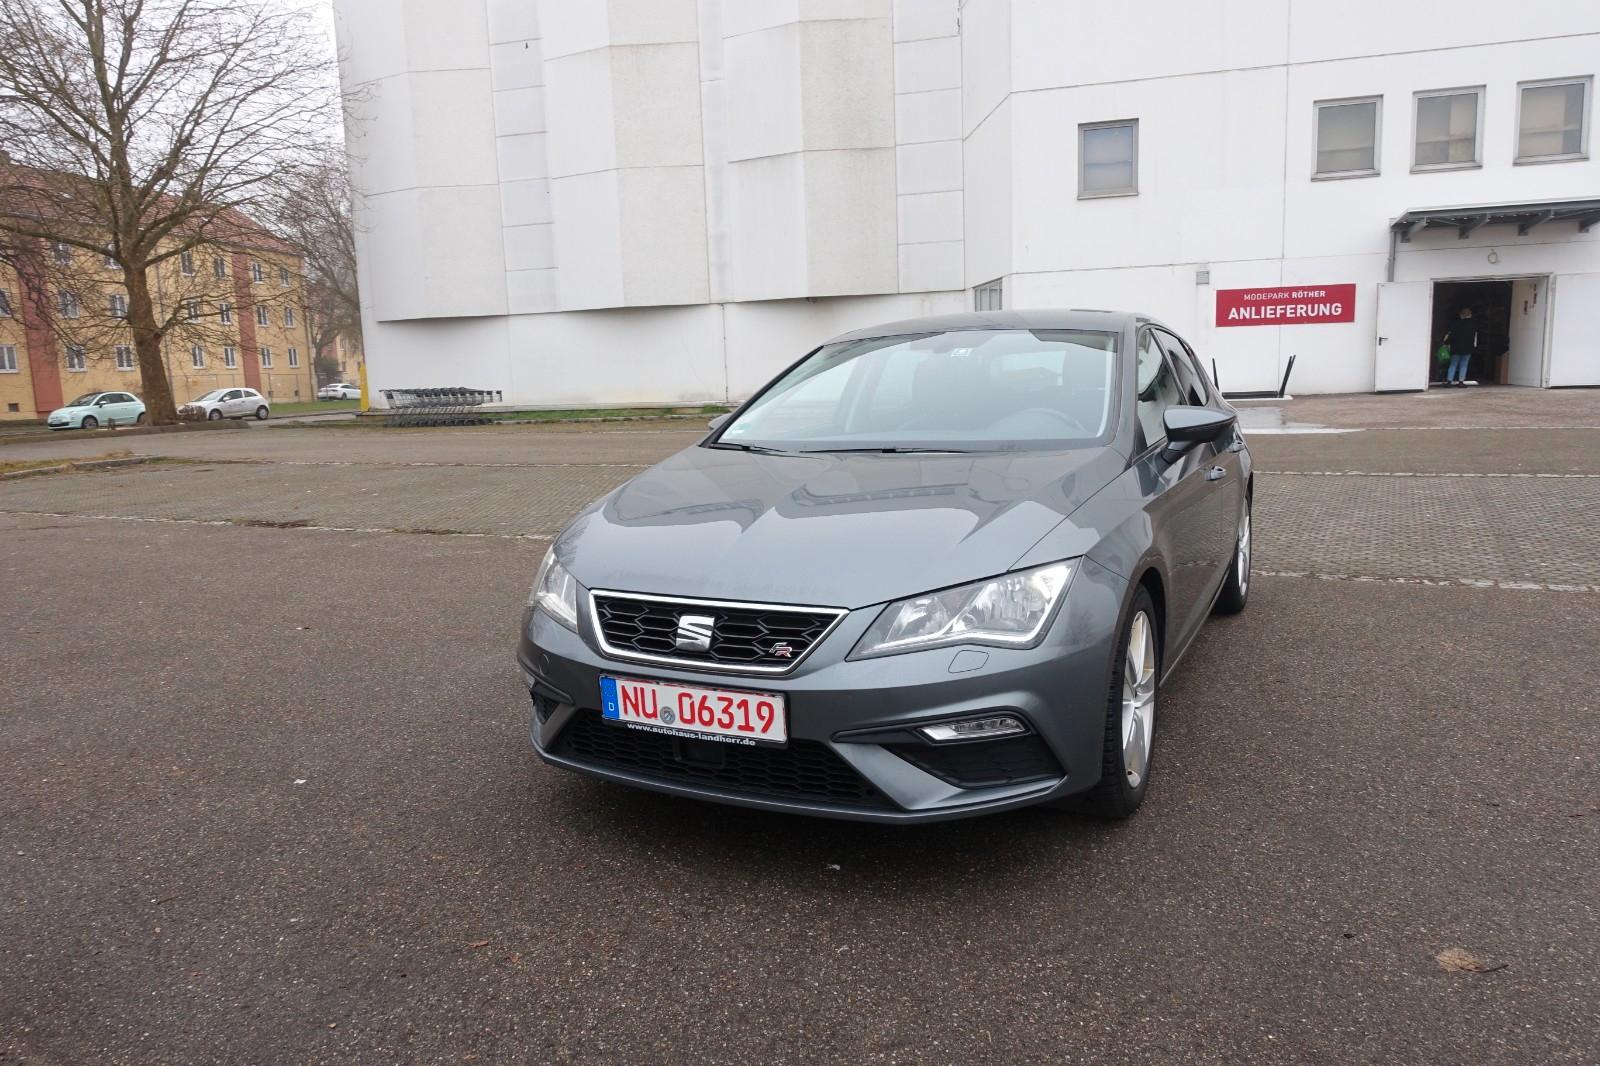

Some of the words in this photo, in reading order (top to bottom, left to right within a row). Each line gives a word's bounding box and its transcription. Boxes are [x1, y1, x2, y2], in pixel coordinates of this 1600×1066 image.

[1243, 292, 1290, 301] MODEPARK
[1291, 289, 1326, 299] RÖTHER
[1227, 302, 1343, 320] ANLIEFERUNG
[769, 641, 793, 658] FR
[608, 702, 615, 711] D
[621, 685, 658, 719] NU
[677, 692, 775, 733] 06319
[627, 723, 756, 746] www.autohaus-landherr.de
